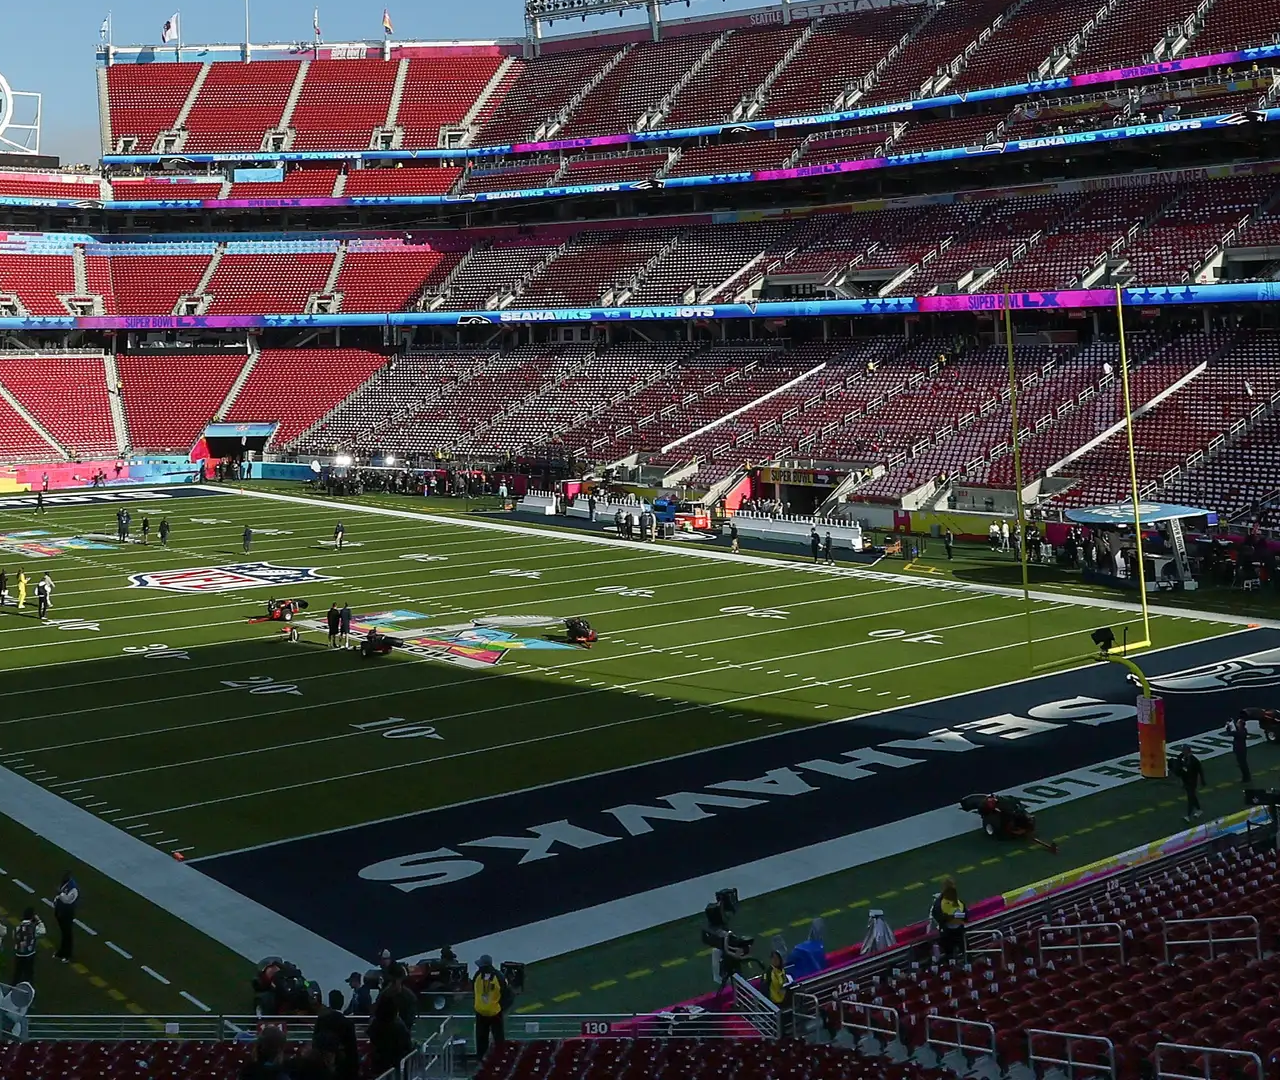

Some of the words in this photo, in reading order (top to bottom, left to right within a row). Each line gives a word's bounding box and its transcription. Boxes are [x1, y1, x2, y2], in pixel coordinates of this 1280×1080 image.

[750, 6, 783, 26] SEATTLE
[1157, 62, 1182, 73] LX
[774, 113, 840, 127] SEAHAWKS
[859, 104, 913, 117] PATRIOTS
[1018, 130, 1097, 150] SEAHAWKS
[1103, 131, 1119, 139] VS
[1125, 120, 1202, 136] PATRIOTS
[486, 189, 544, 200] SEAHAWKS
[565, 184, 621, 195] PATRIOTS
[968, 295, 995, 309] SUPER
[1022, 293, 1060, 307] LX
[125, 317, 150, 328] SUPER
[151, 317, 173, 328] BOWL
[176, 317, 208, 328] LX
[500, 309, 592, 321] SEAHAWKS
[603, 309, 621, 318] VS
[630, 307, 715, 319] PATRIOTS
[220, 675, 303, 696] 20
[349, 716, 446, 740] 10
[359, 694, 1138, 893] SEAHAWKS
[584, 1022, 609, 1034] 130
